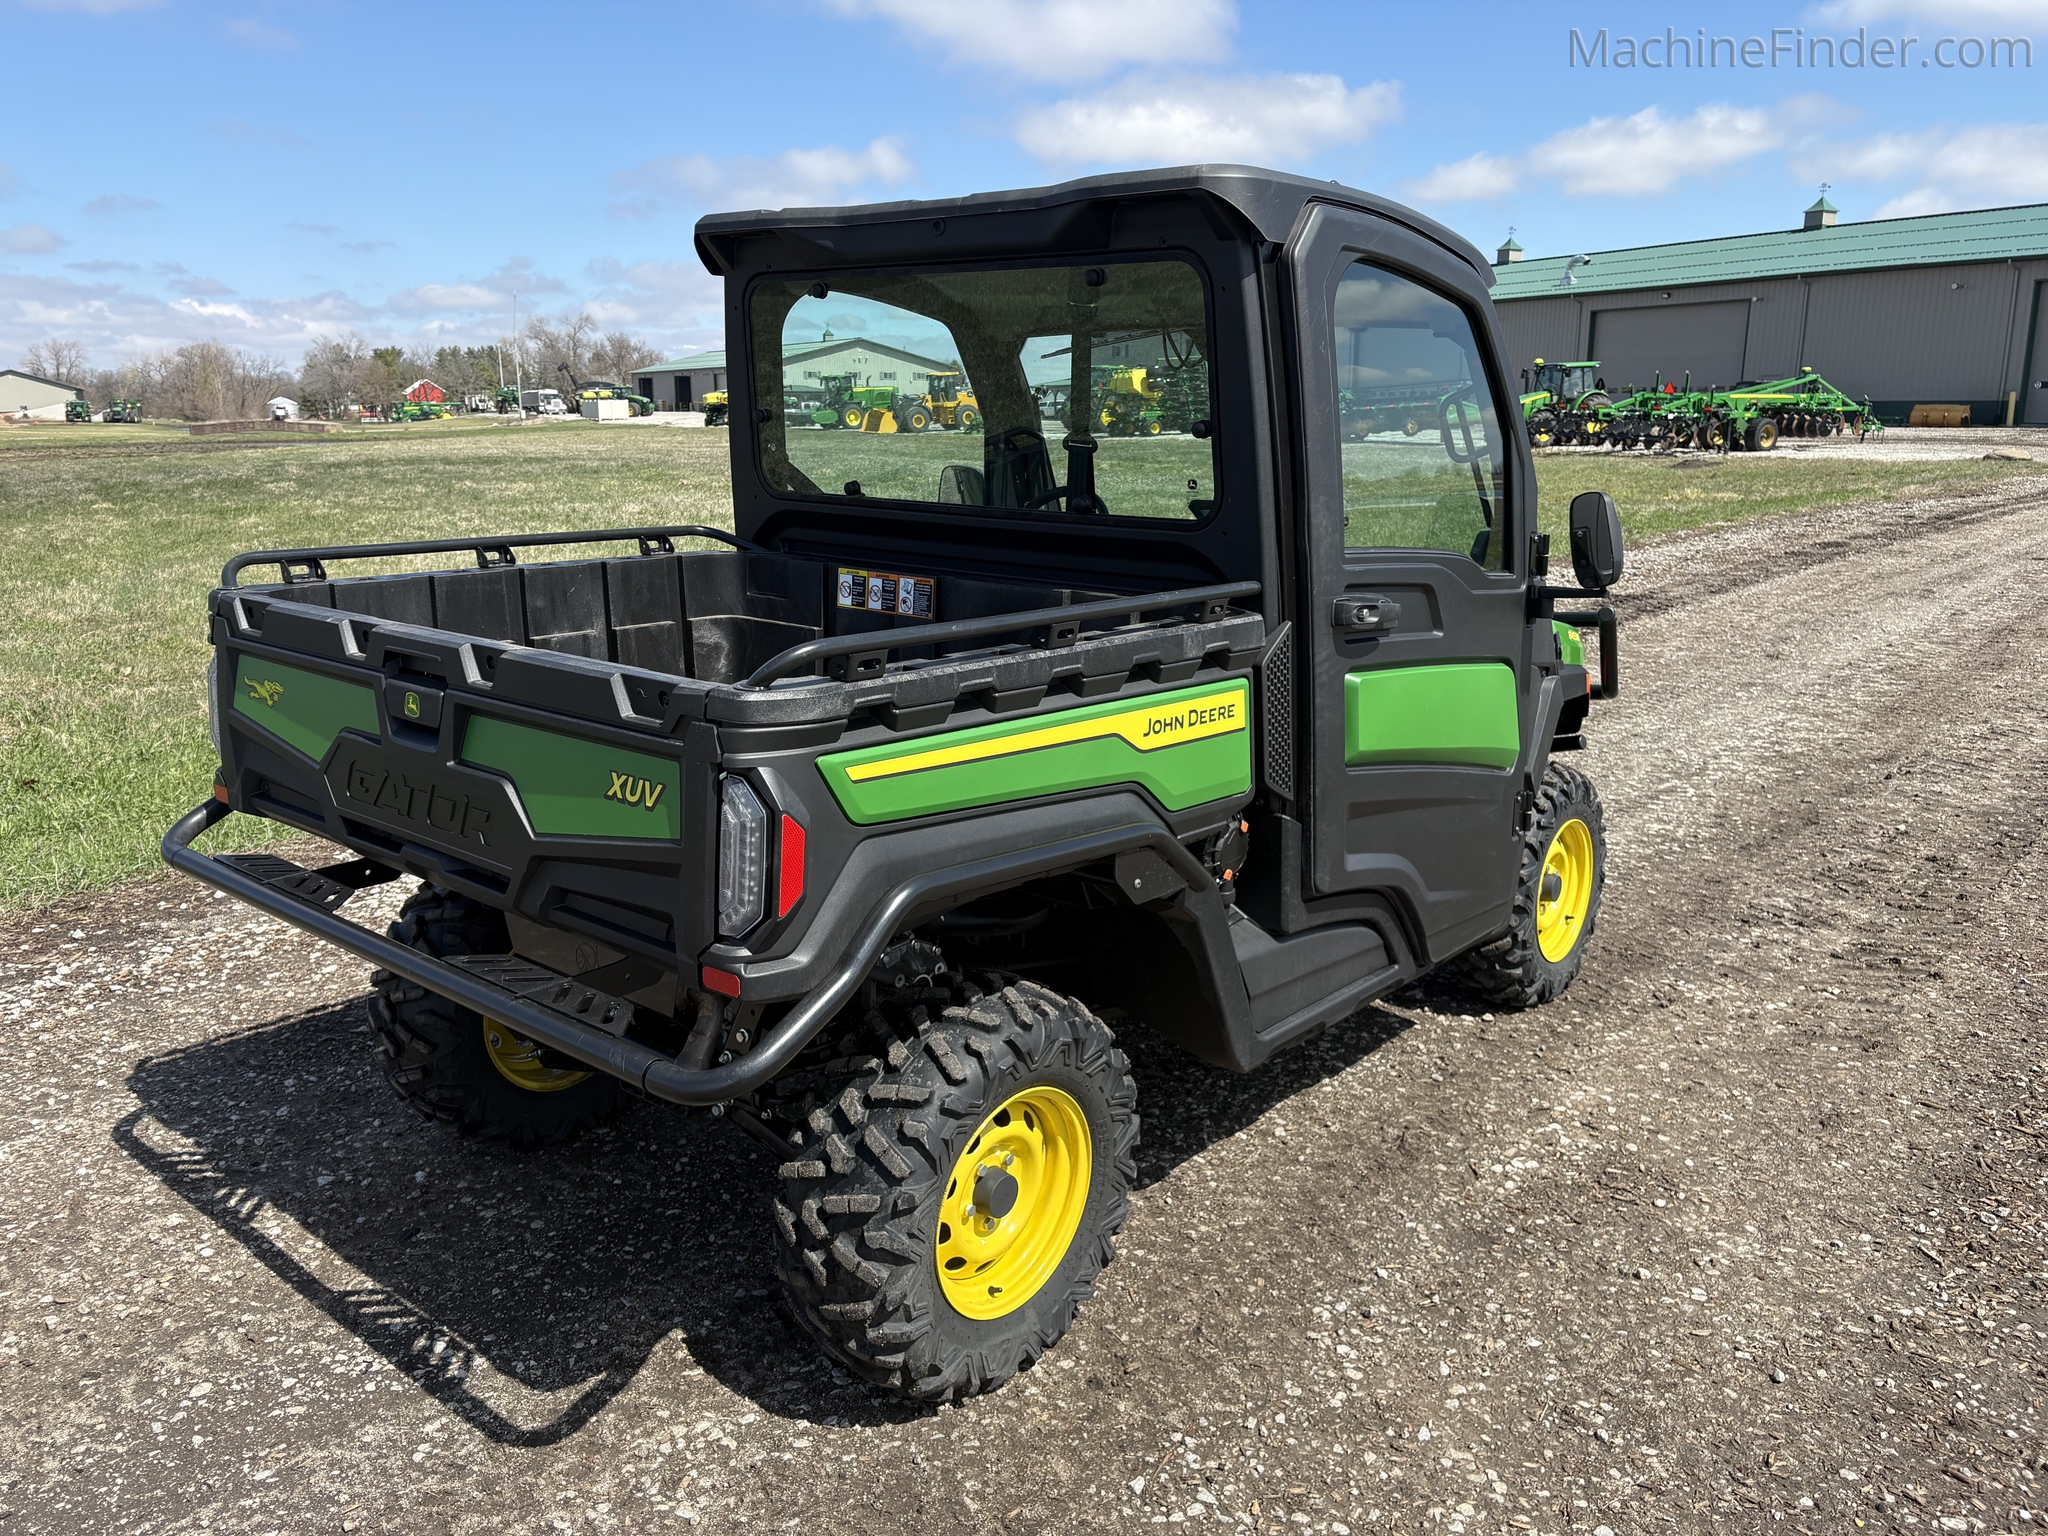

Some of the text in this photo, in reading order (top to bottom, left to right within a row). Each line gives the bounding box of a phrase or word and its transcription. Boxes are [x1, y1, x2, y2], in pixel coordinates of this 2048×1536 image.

[1143, 704, 1235, 737] JOHN DEERE
[346, 760, 493, 847] GATOR
[605, 770, 665, 810] XUV
